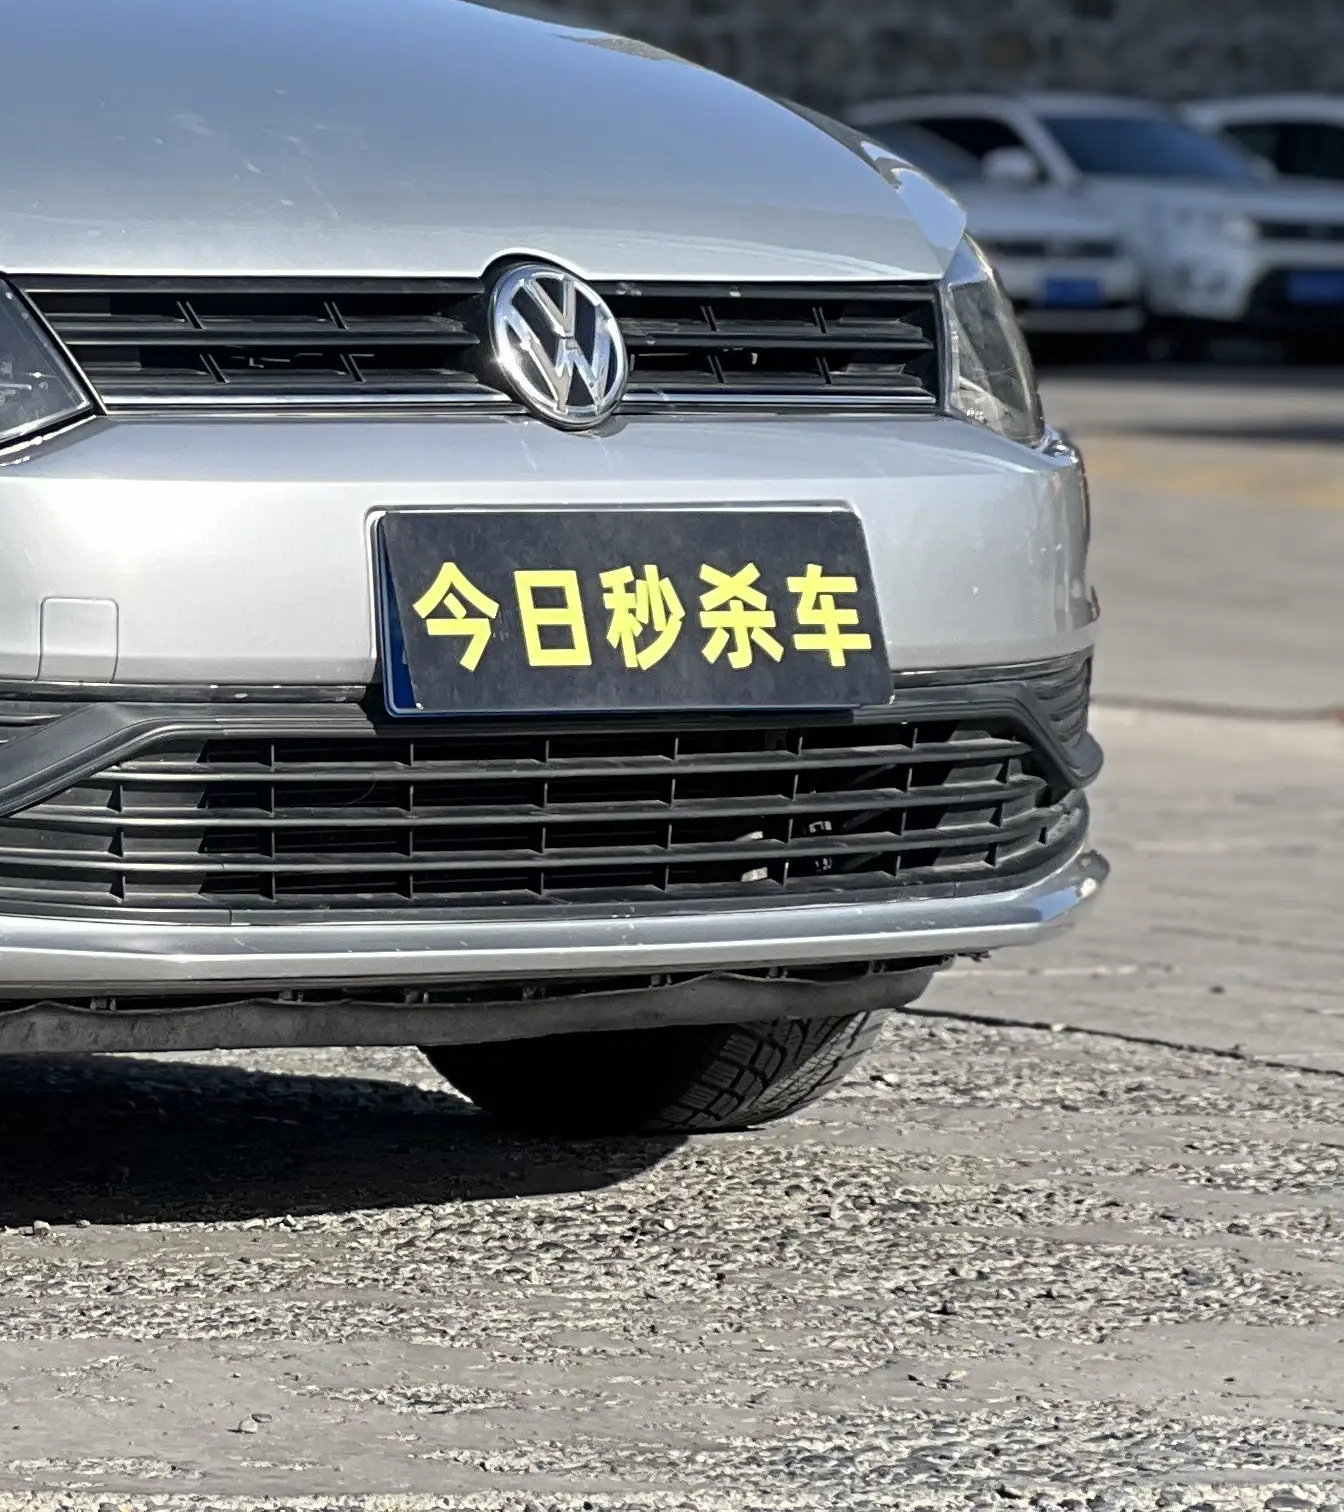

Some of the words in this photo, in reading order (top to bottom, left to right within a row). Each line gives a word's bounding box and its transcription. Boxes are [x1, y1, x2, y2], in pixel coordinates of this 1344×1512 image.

[413, 561, 872, 671] 今日秒杀车
